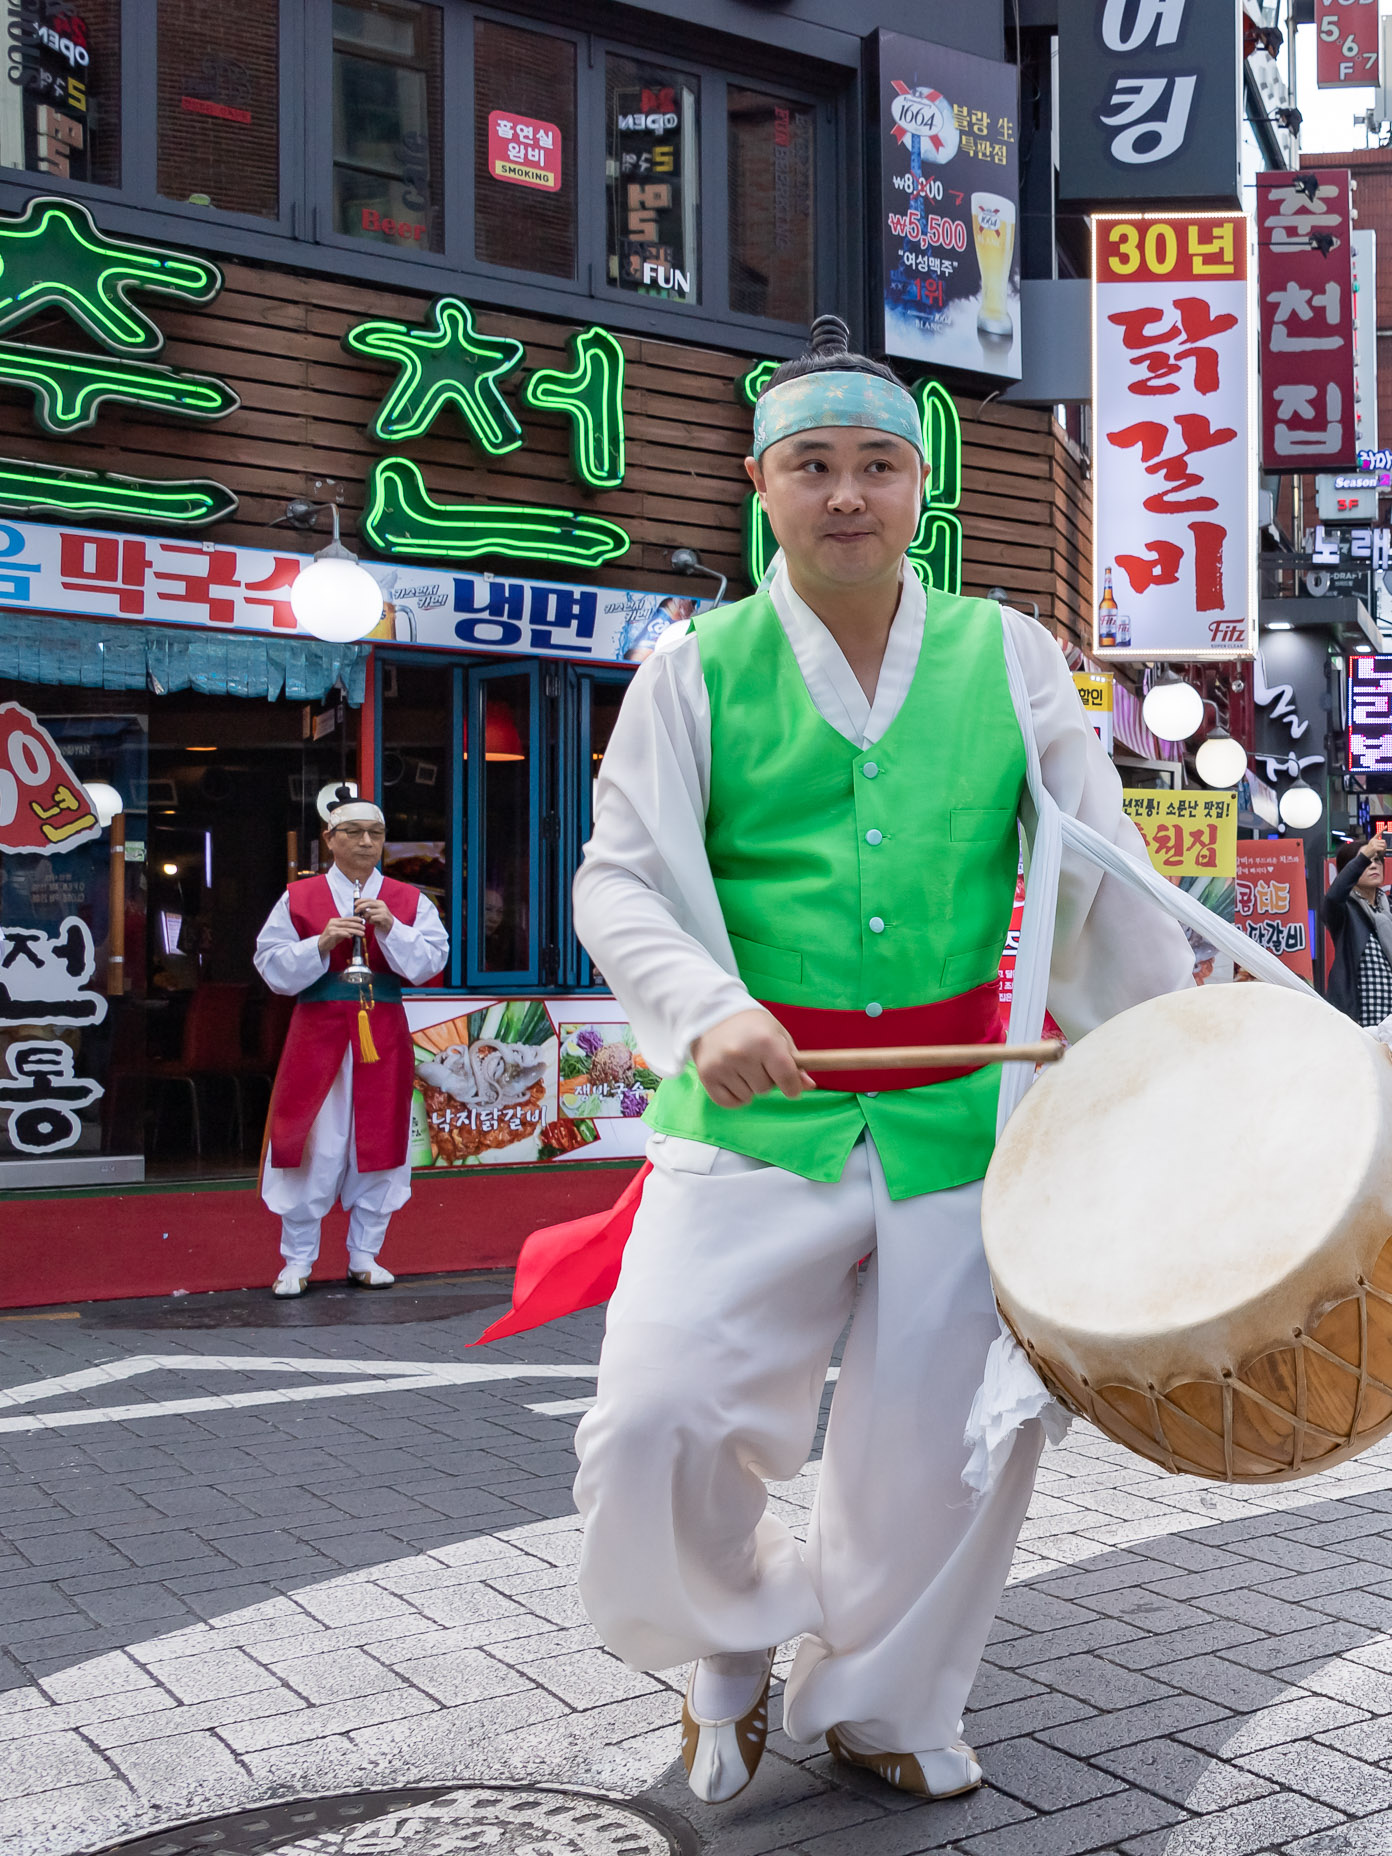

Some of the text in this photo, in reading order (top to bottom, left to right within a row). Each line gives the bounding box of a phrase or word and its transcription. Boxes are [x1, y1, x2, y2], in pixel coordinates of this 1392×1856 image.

[1340, 62, 1353, 80] F
[899, 103, 936, 132] 1664
[953, 104, 990, 136] 블랑
[496, 119, 554, 149] 흡연실
[507, 142, 545, 167] 완비
[960, 136, 1007, 165] 특판점
[501, 164, 550, 183] SMOKING
[361, 208, 427, 241] Beer
[1107, 223, 1235, 275] 30년
[642, 262, 691, 293] FUN
[914, 278, 943, 307] 1위
[1106, 297, 1240, 612] 닭갈비
[1335, 473, 1391, 489] Season 2
[1337, 498, 1360, 511] 3F
[58, 533, 301, 629] 막국수
[453, 577, 598, 653] 냉면
[1208, 618, 1246, 642] Fitz
[1165, 798, 1199, 818] 소문난
[1203, 801, 1231, 819] 맛집!
[1137, 822, 1219, 868] 천집
[432, 1105, 548, 1133] 낙지닭갈비
